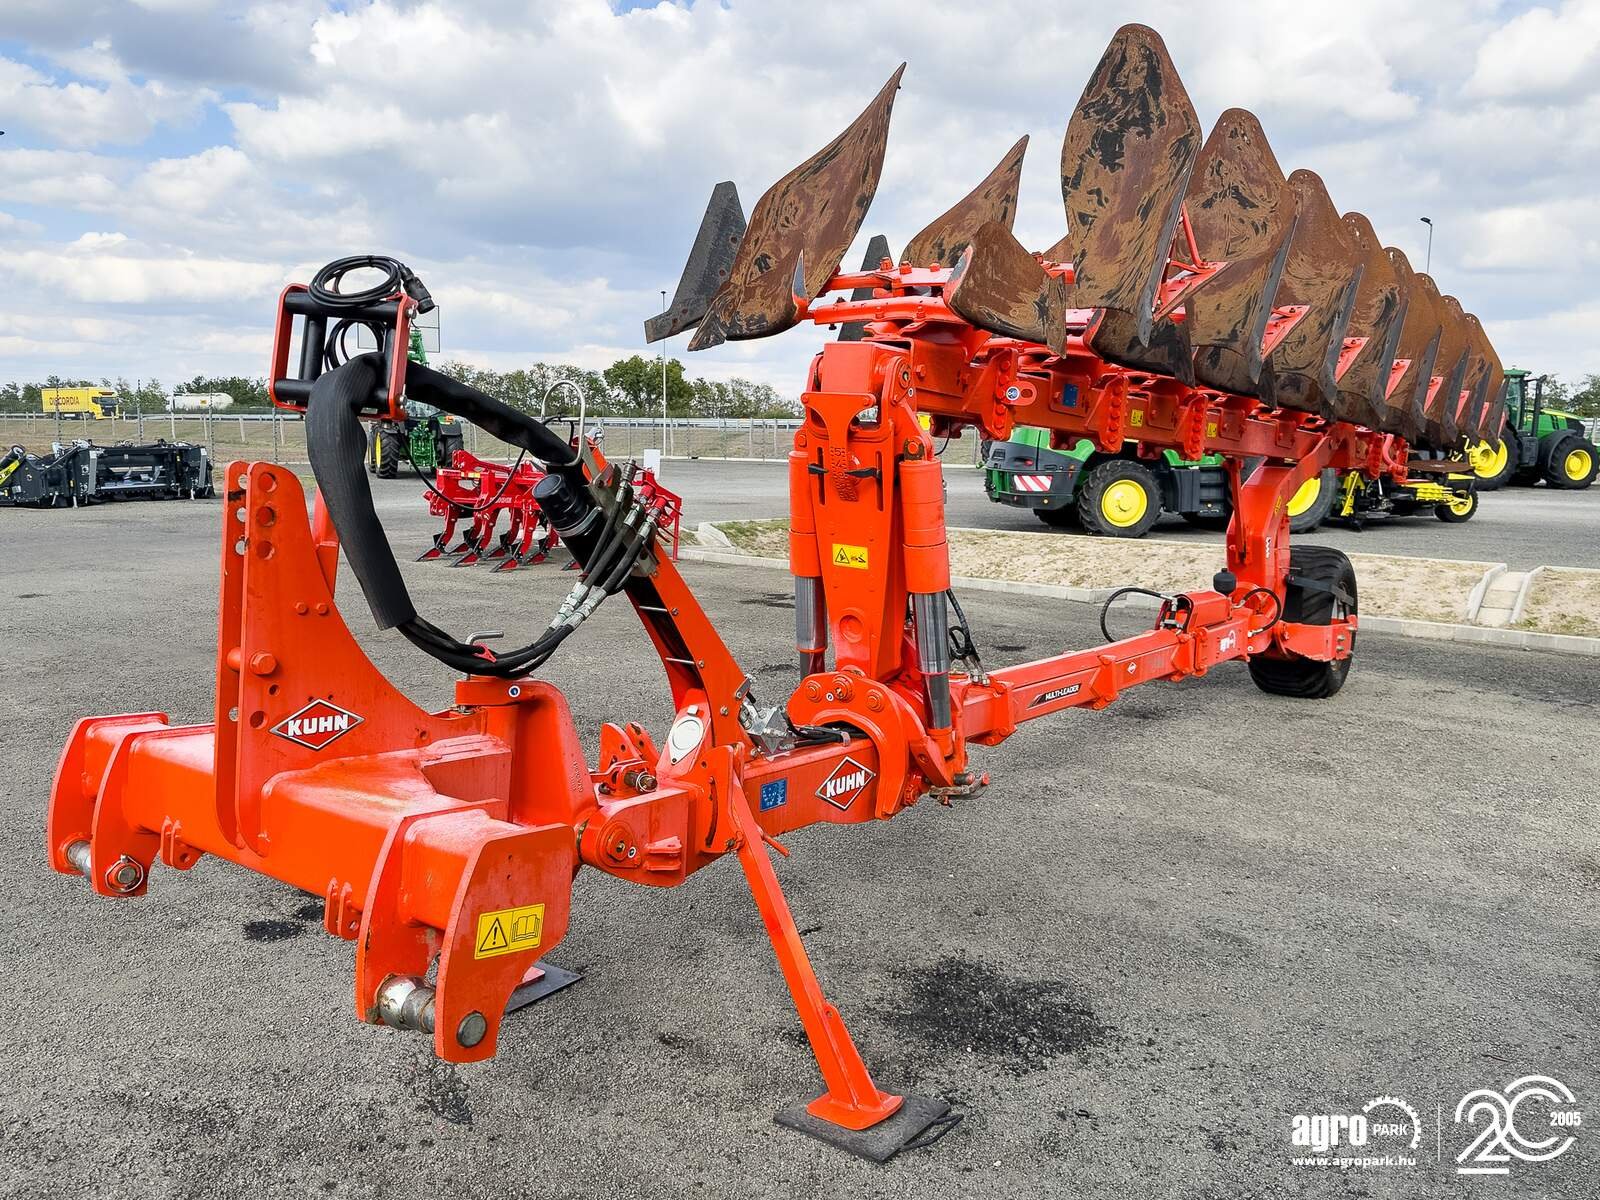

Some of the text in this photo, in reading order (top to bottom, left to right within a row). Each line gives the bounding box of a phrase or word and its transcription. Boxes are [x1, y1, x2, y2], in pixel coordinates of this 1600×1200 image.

[1045, 684, 1080, 701] MULTI-LEADER
[287, 714, 349, 737] KUHN
[826, 769, 866, 798] KUHN
